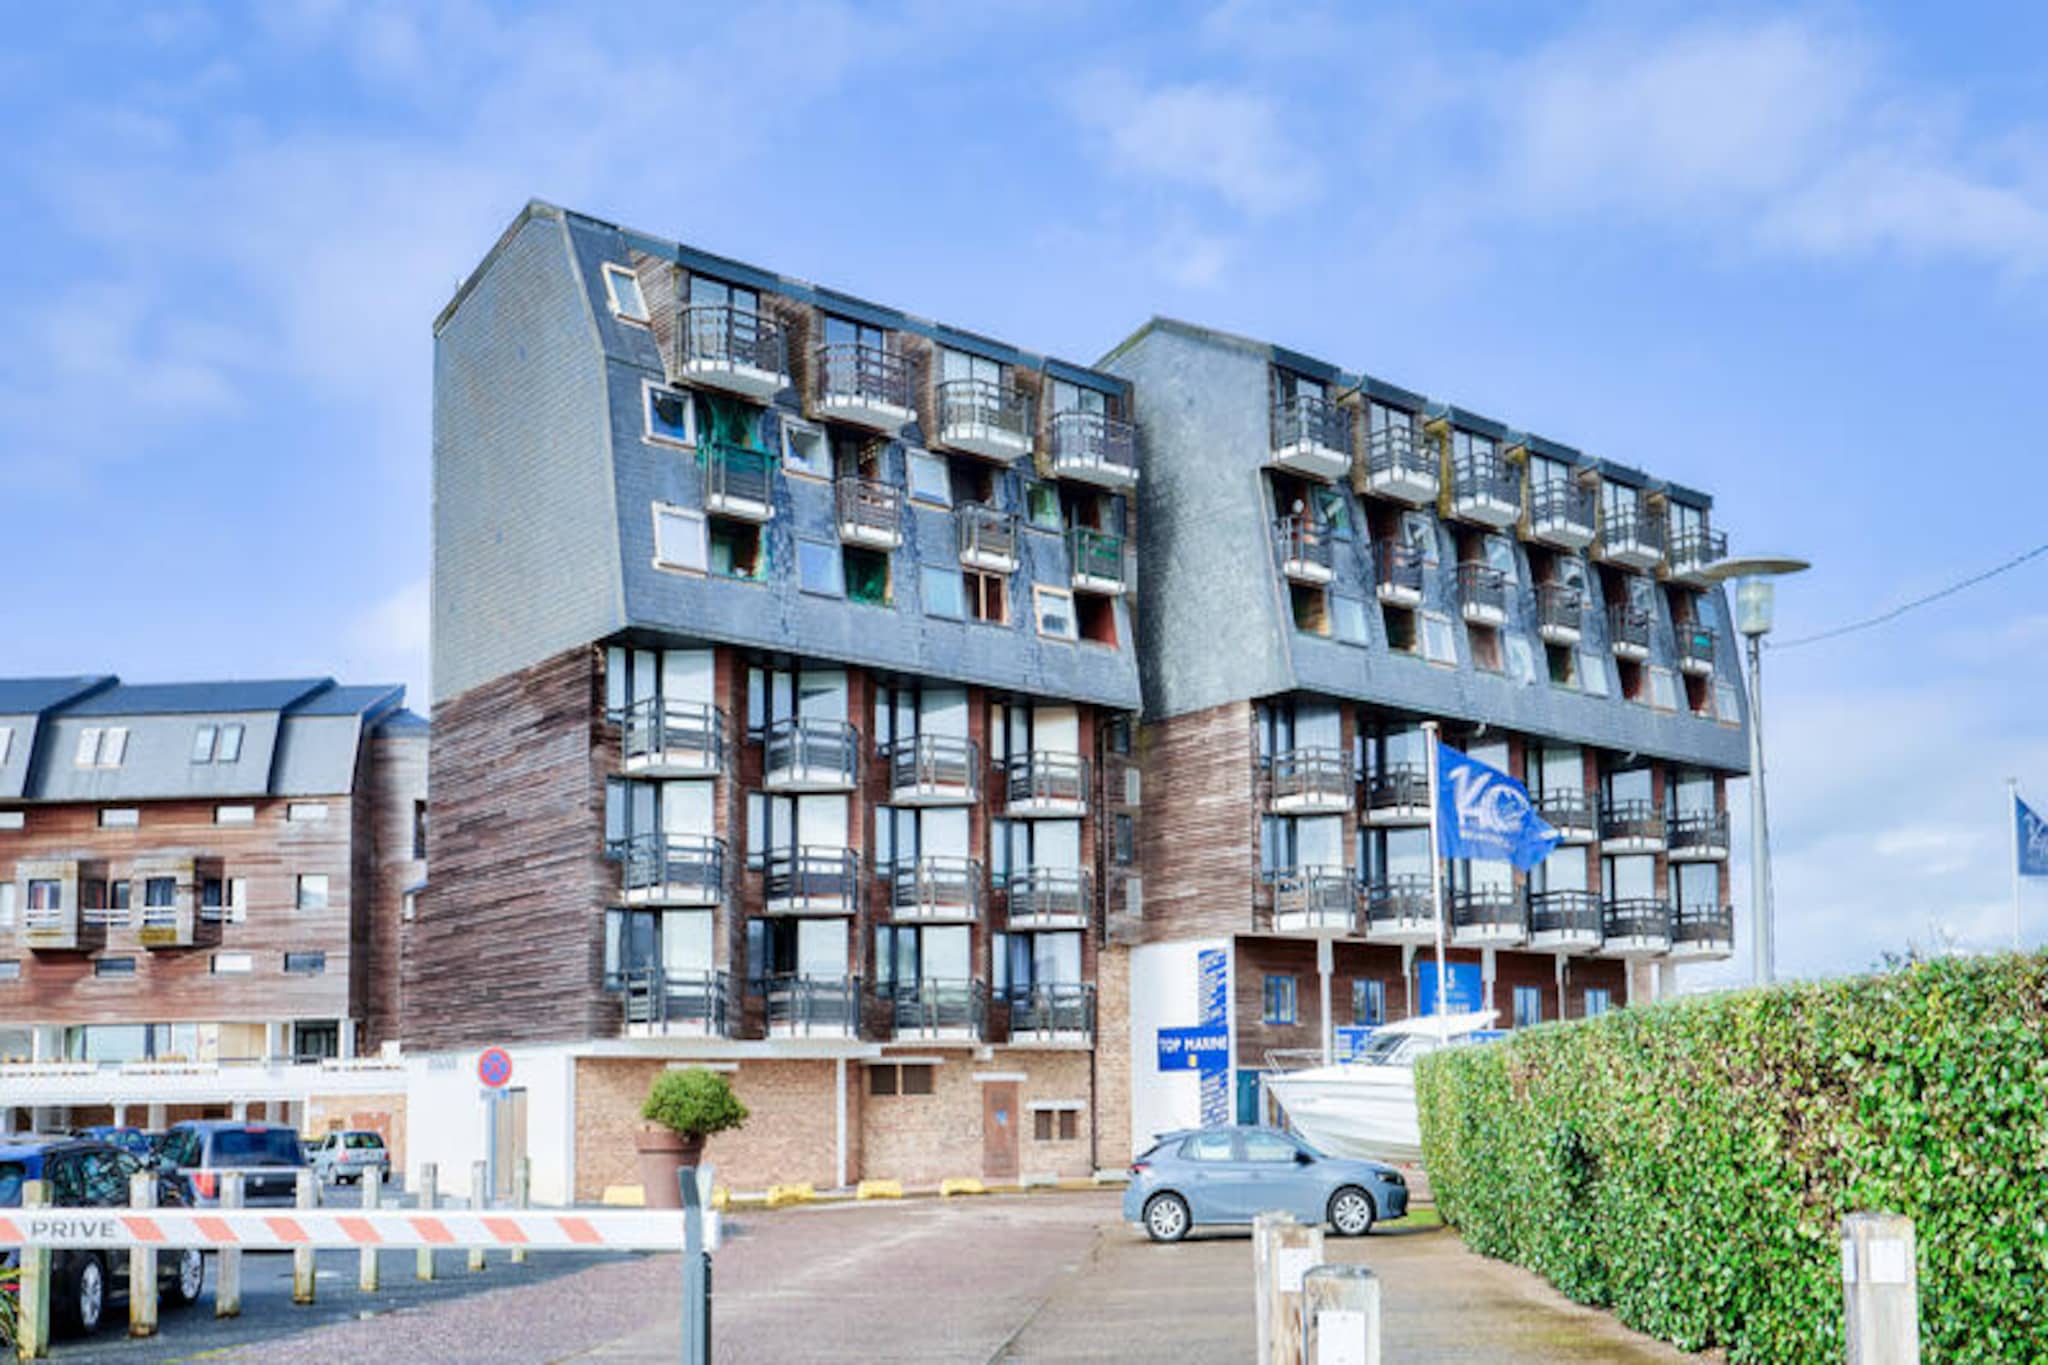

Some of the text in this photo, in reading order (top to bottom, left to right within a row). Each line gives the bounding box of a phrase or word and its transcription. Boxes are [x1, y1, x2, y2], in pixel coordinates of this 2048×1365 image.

[1159, 1035, 1228, 1053] TOP MARINE
[31, 1221, 117, 1238] PRIVE
